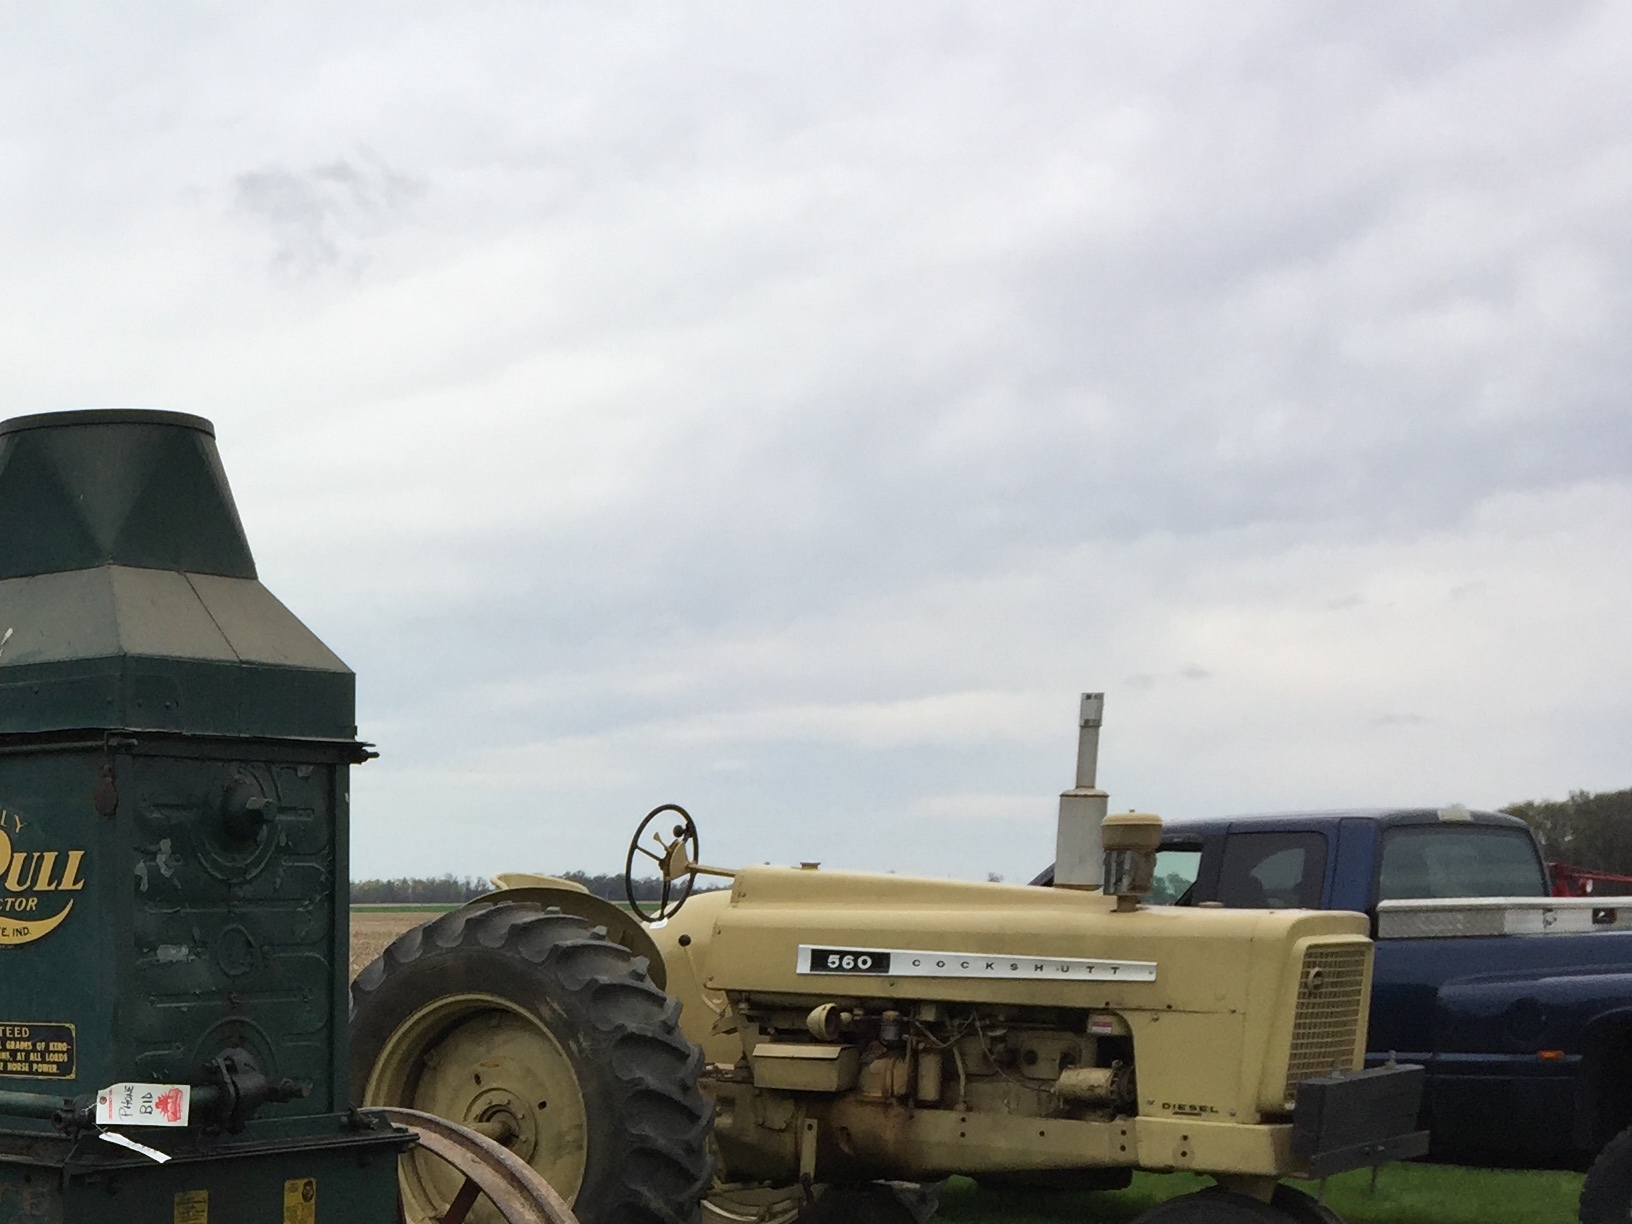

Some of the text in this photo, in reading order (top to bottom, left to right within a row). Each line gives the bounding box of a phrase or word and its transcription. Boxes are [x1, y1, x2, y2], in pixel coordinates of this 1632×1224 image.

[827, 954, 1119, 975] 560 COCKSHUTT
[36, 1042, 45, 1051] OF
[17, 1052, 25, 1060] AT
[30, 1052, 41, 1061] ALL
[119, 1085, 134, 1121] PHONE
[139, 1091, 154, 1115] BID
[1162, 1102, 1219, 1113] DIESEL
